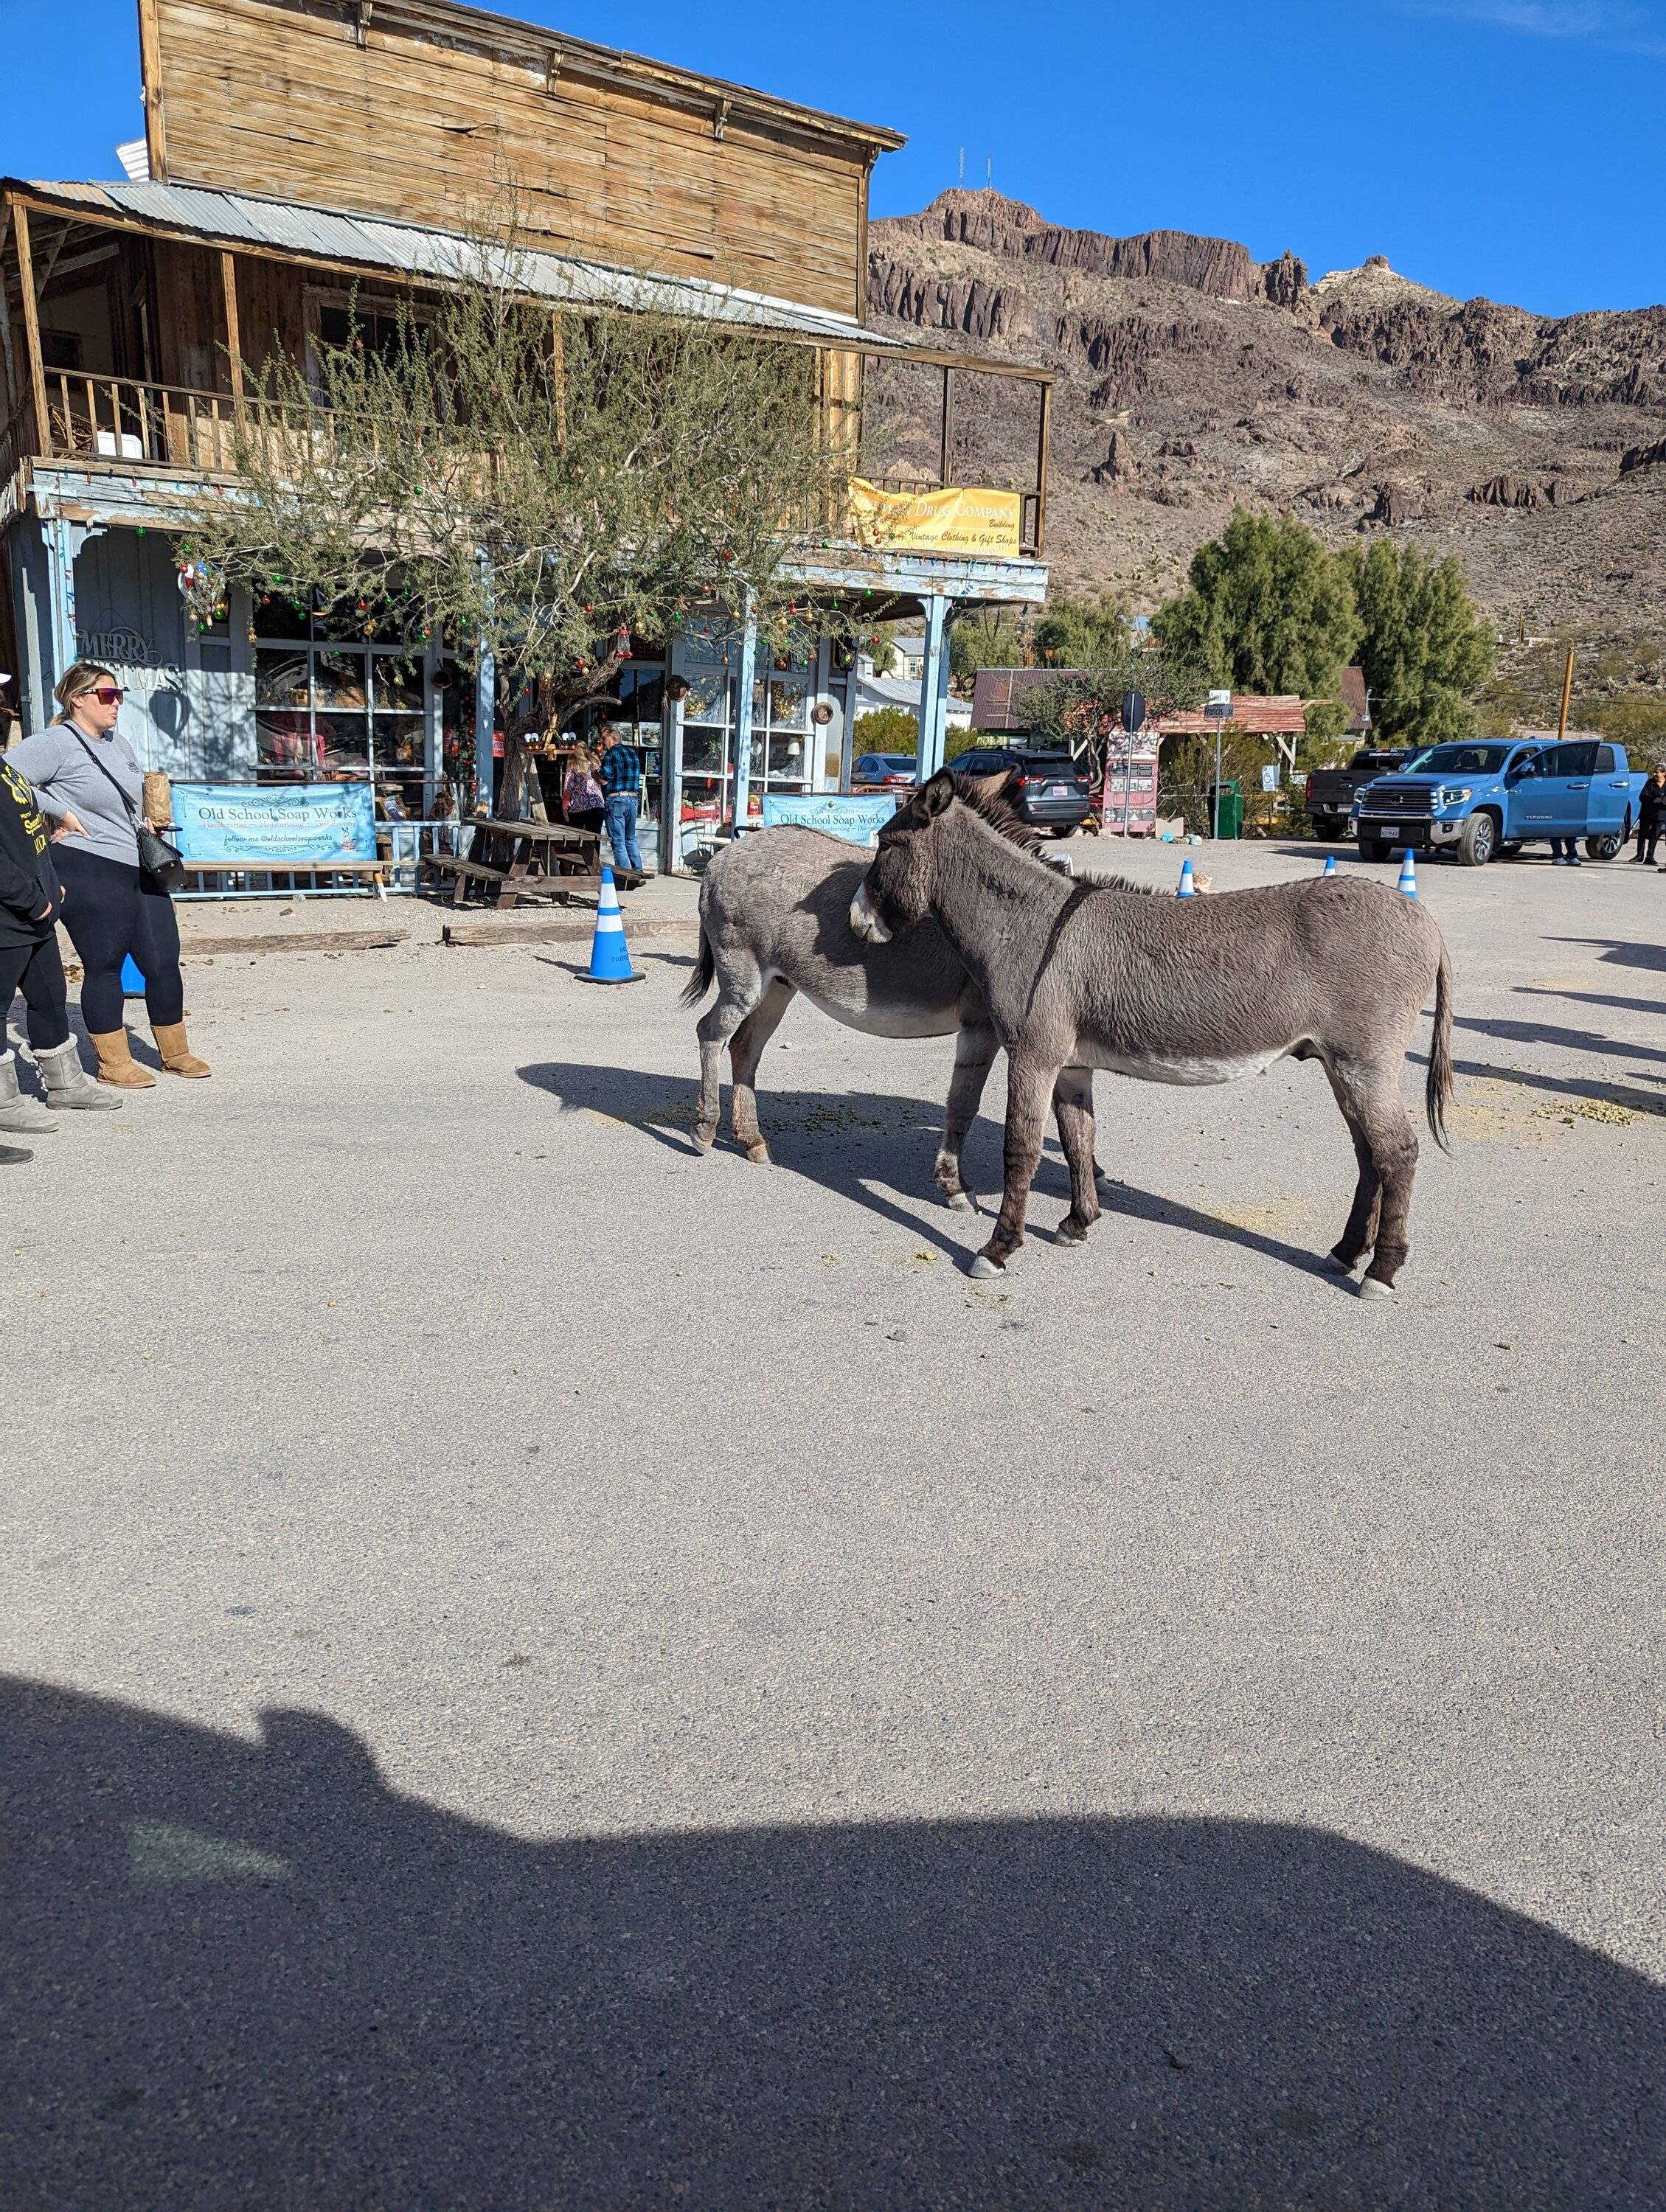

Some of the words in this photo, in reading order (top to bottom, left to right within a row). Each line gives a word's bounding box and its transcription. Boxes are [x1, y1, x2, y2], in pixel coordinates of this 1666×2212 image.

[914, 498, 950, 517] DRUG
[955, 501, 1016, 519] COMPANY
[988, 518, 1015, 531] Building
[909, 532, 938, 543] Vintage
[941, 531, 969, 544] Clothing
[971, 533, 976, 542] &
[979, 534, 994, 546] Gift
[996, 535, 1016, 546] Shops
[76, 627, 163, 667] MERRY
[1204, 707, 1224, 716] Francis
[198, 807, 224, 820] Old
[228, 807, 275, 820] School
[277, 807, 310, 822] Soap
[313, 807, 357, 819] Works
[780, 813, 797, 824] Old
[800, 813, 830, 825] School
[833, 813, 855, 827] Soap
[858, 813, 885, 824] Works
[223, 835, 247, 846] follow
